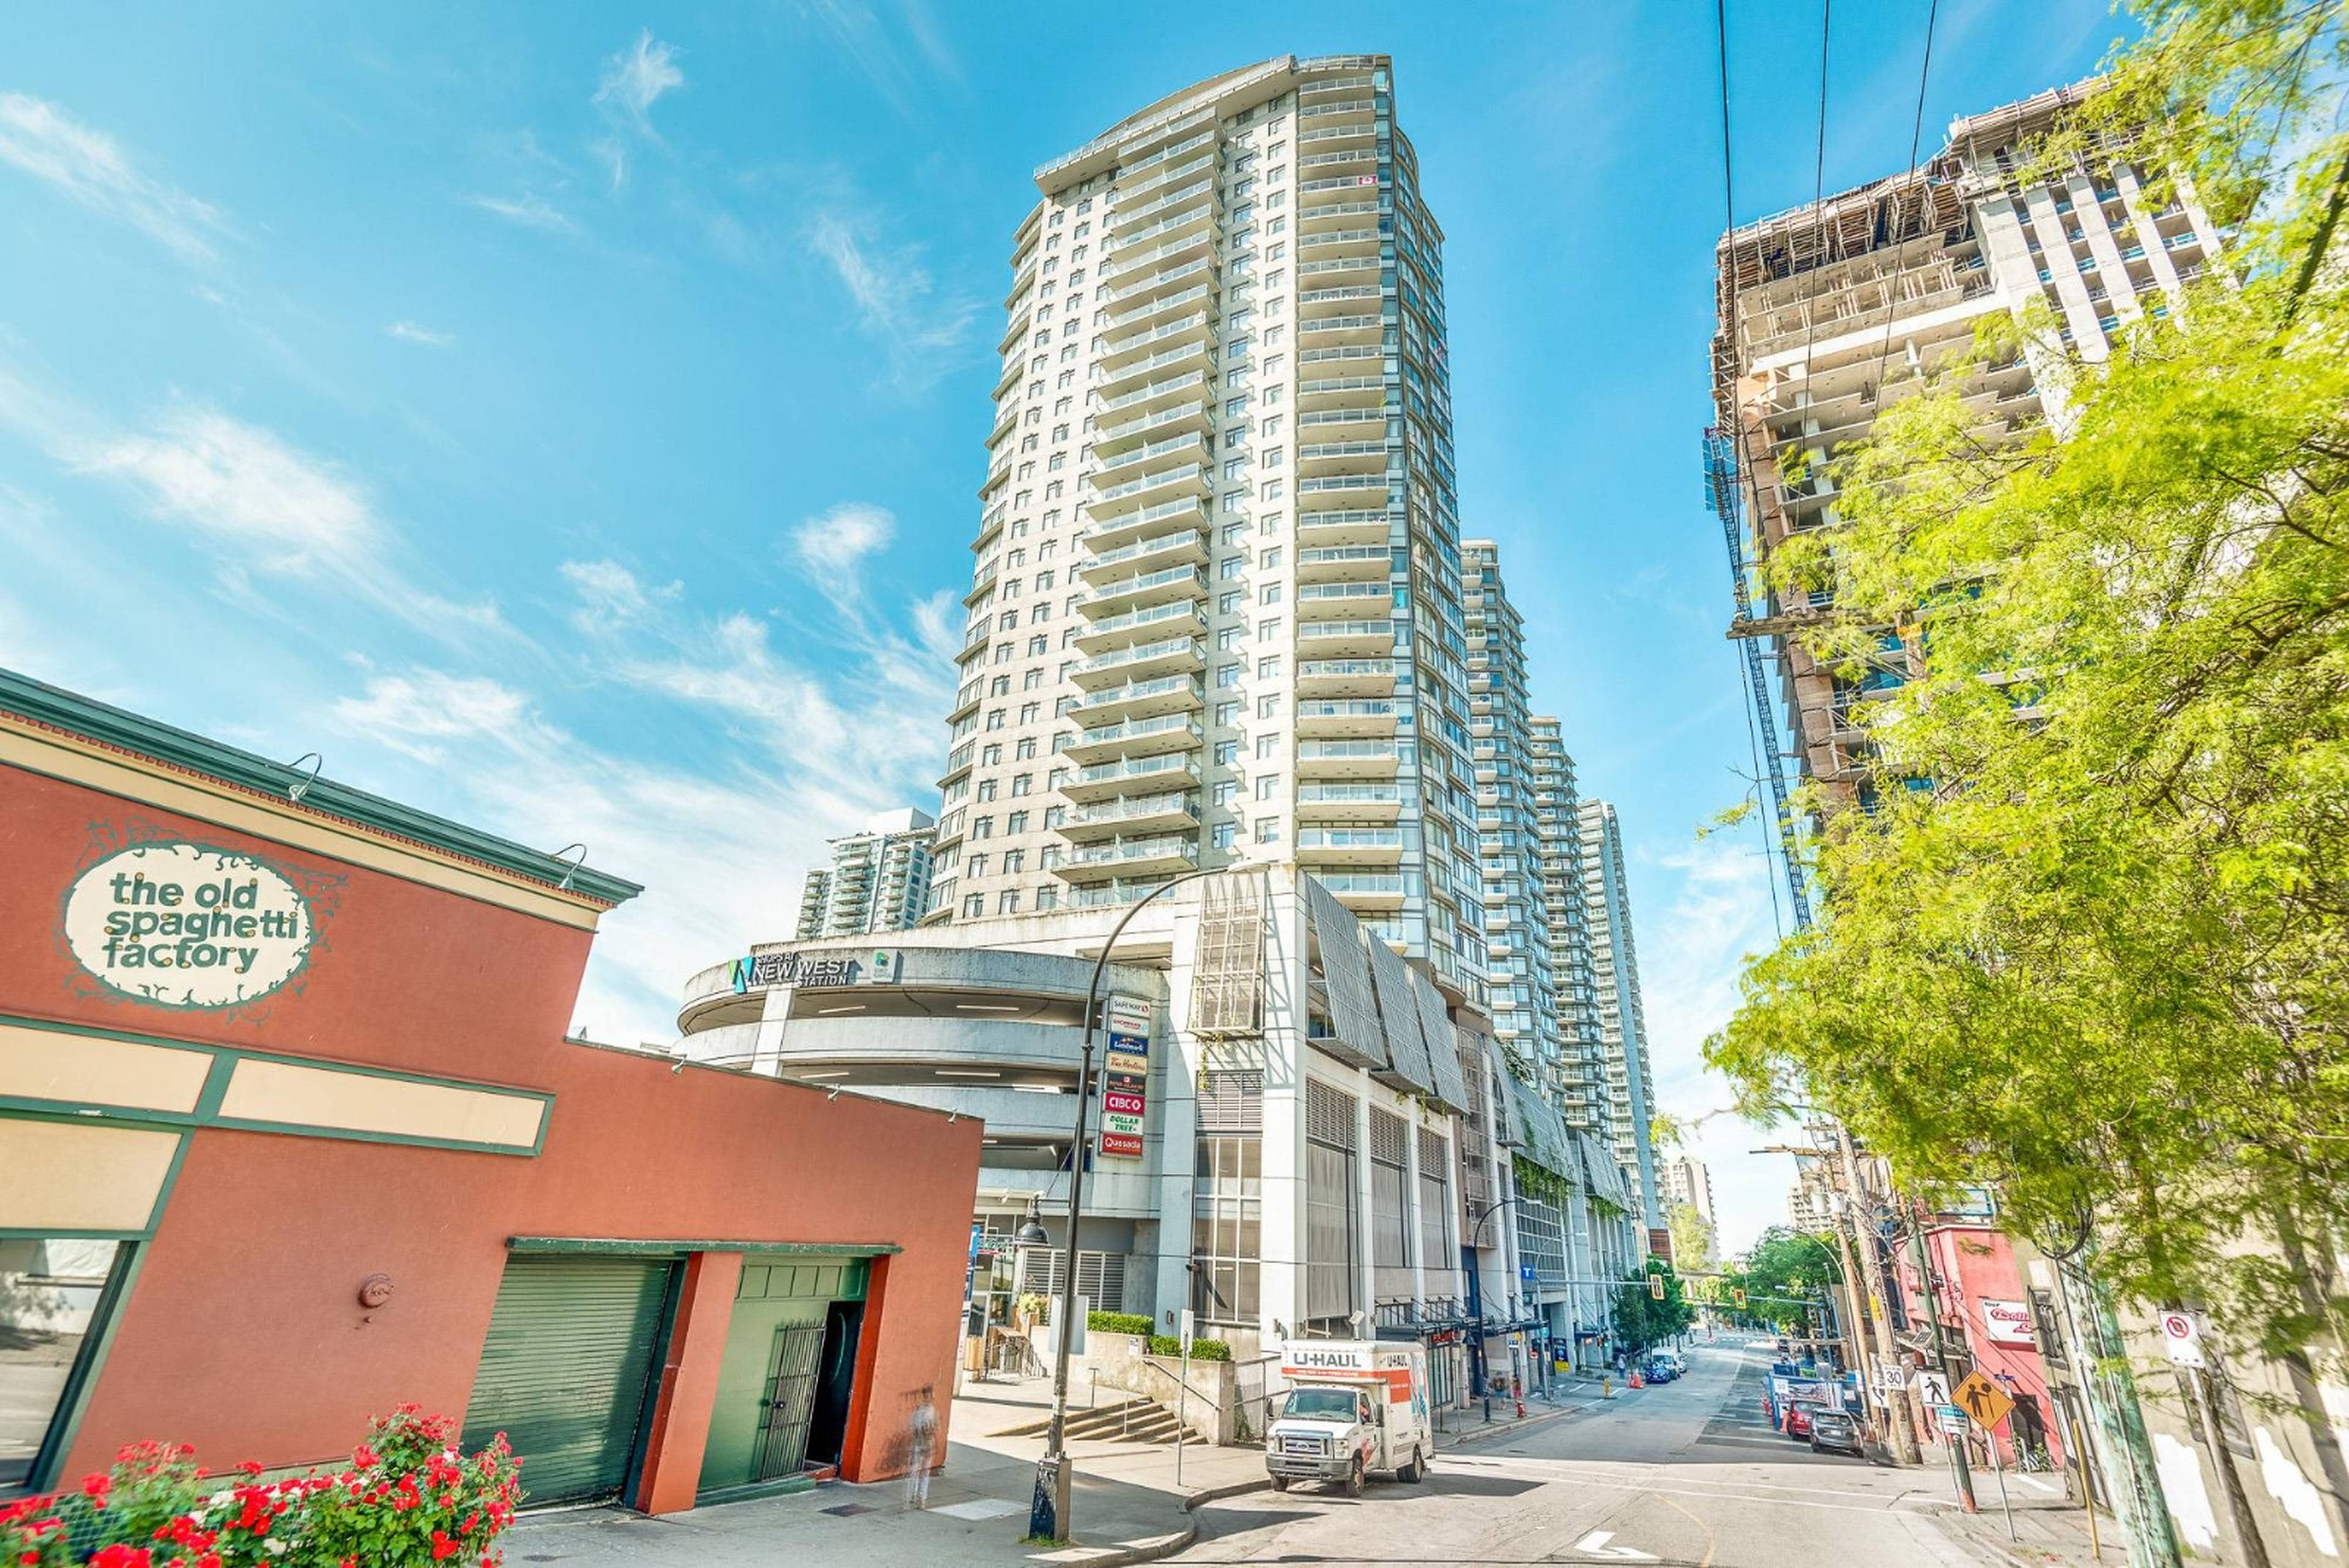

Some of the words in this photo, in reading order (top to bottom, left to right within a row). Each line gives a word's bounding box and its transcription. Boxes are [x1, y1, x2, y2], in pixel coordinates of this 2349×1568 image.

[110, 872, 184, 905] the
[195, 877, 258, 909] old
[104, 905, 298, 943] spaghetti
[102, 937, 259, 974] factory
[752, 962, 793, 984] NEW
[796, 959, 852, 976] WEST
[795, 975, 847, 987] STATION
[1109, 1096, 1132, 1109] CIBC
[1109, 1115, 1139, 1124] DOLLAR
[1105, 1137, 1141, 1149] Quesada
[1523, 1267, 1531, 1277] T
[1294, 1353, 1362, 1368] U-HAUL
[1886, 1370, 1902, 1384] 30
